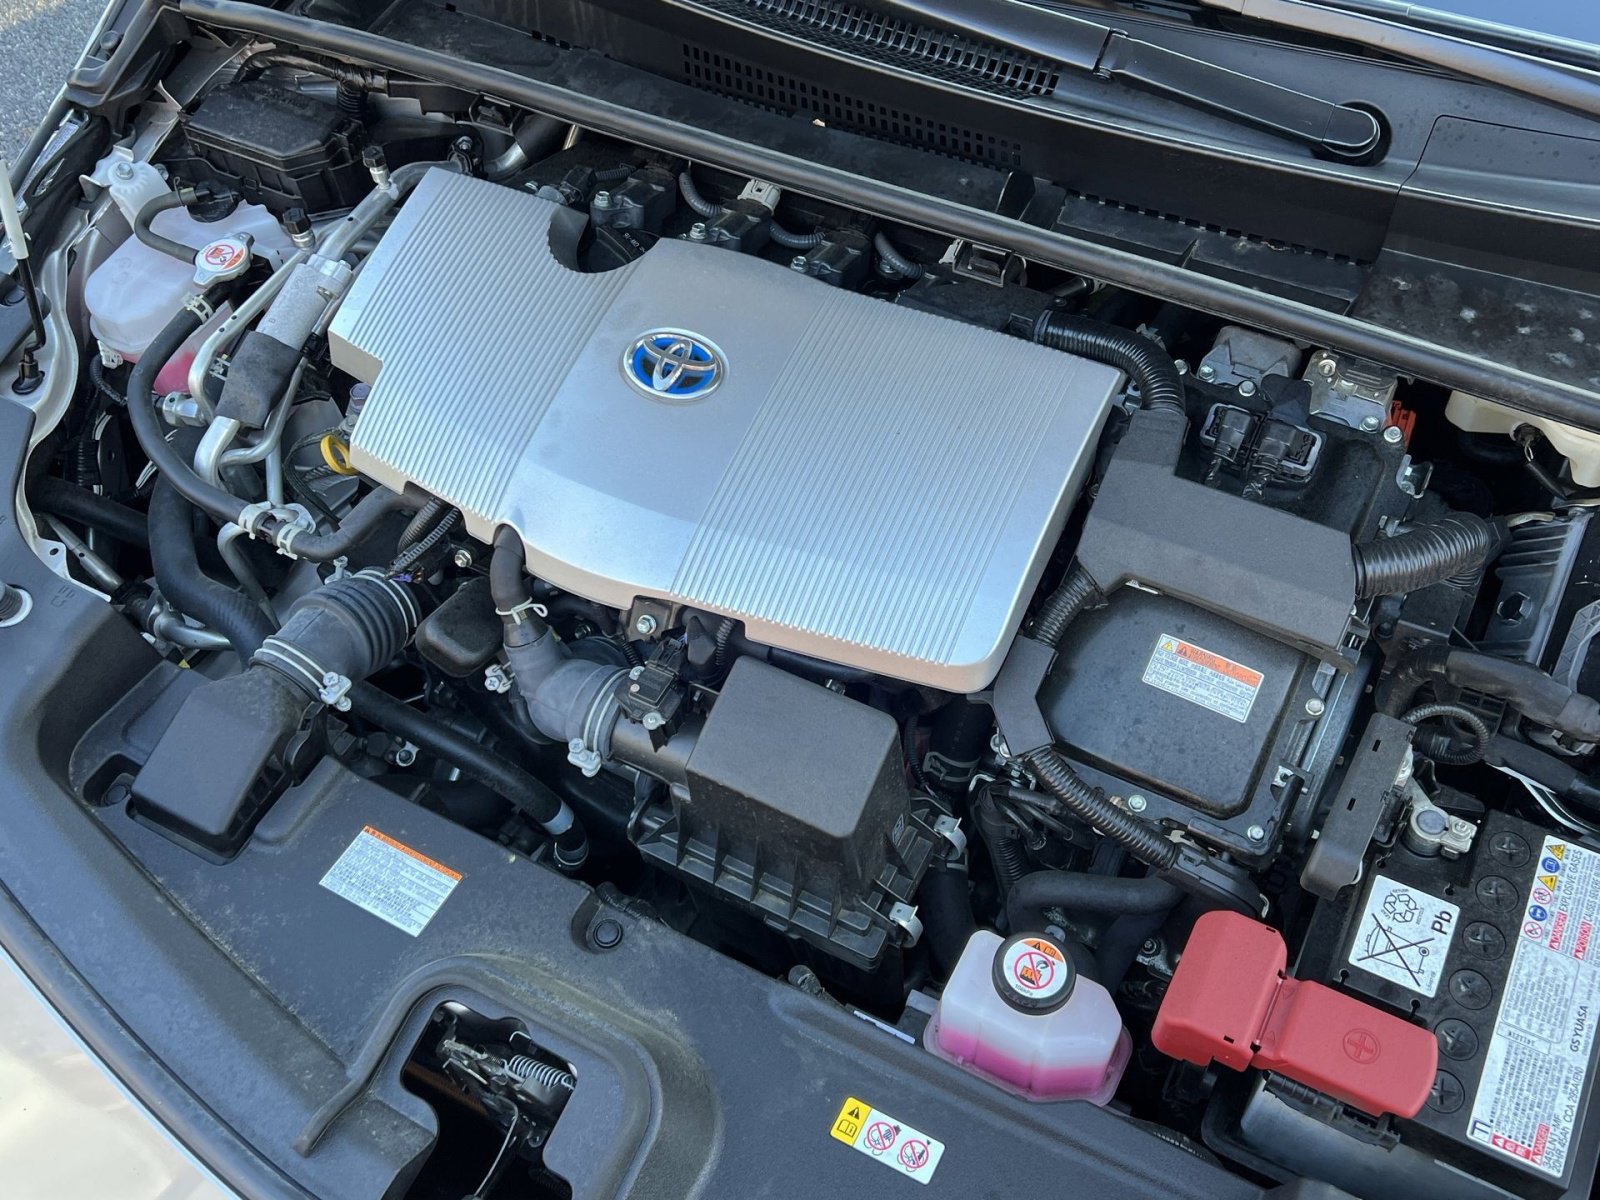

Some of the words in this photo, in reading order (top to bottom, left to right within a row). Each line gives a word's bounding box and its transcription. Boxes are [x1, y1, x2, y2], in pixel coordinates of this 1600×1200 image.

[1558, 872, 1577, 912] EXPLOSIVE
[1568, 849, 1583, 873] GASES
[1430, 910, 1453, 936] Pb
[1576, 922, 1591, 951] POISON
[1572, 1004, 1589, 1038] YUASA
[1570, 1038, 1581, 1052] GS
[1563, 1103, 1575, 1123] CCA
[1534, 1124, 1549, 1154] DANGER
[1557, 1125, 1570, 1148] 45Ah
[1552, 1147, 1564, 1172] 20HR
